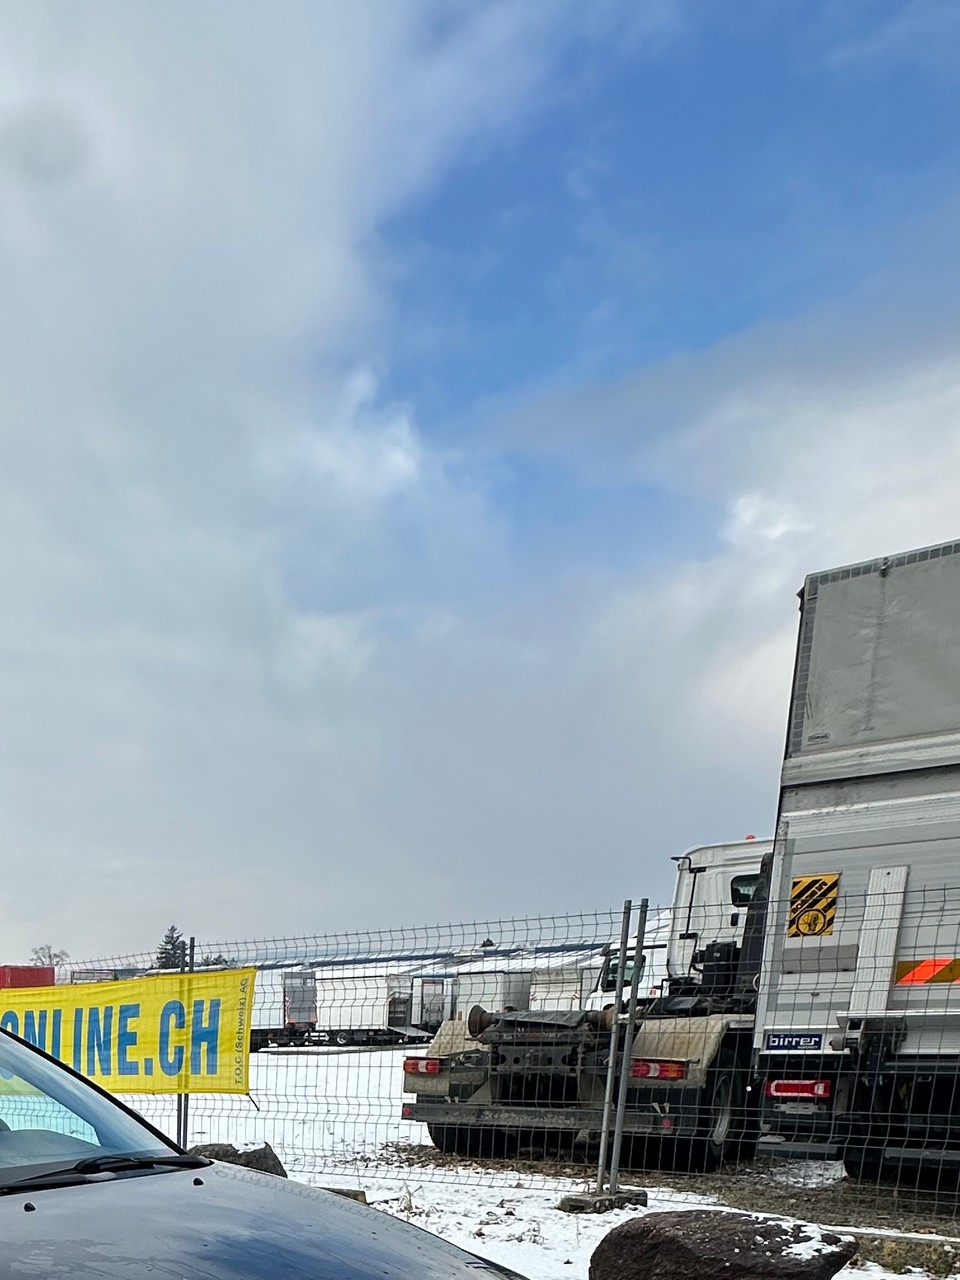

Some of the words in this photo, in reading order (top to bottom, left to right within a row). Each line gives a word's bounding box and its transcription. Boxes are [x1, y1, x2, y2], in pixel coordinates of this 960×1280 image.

[239, 977, 248, 994] AG
[0, 998, 221, 1080] ONLINE.CH
[235, 997, 247, 1053] (Schweiz)
[770, 1034, 819, 1046] birrer
